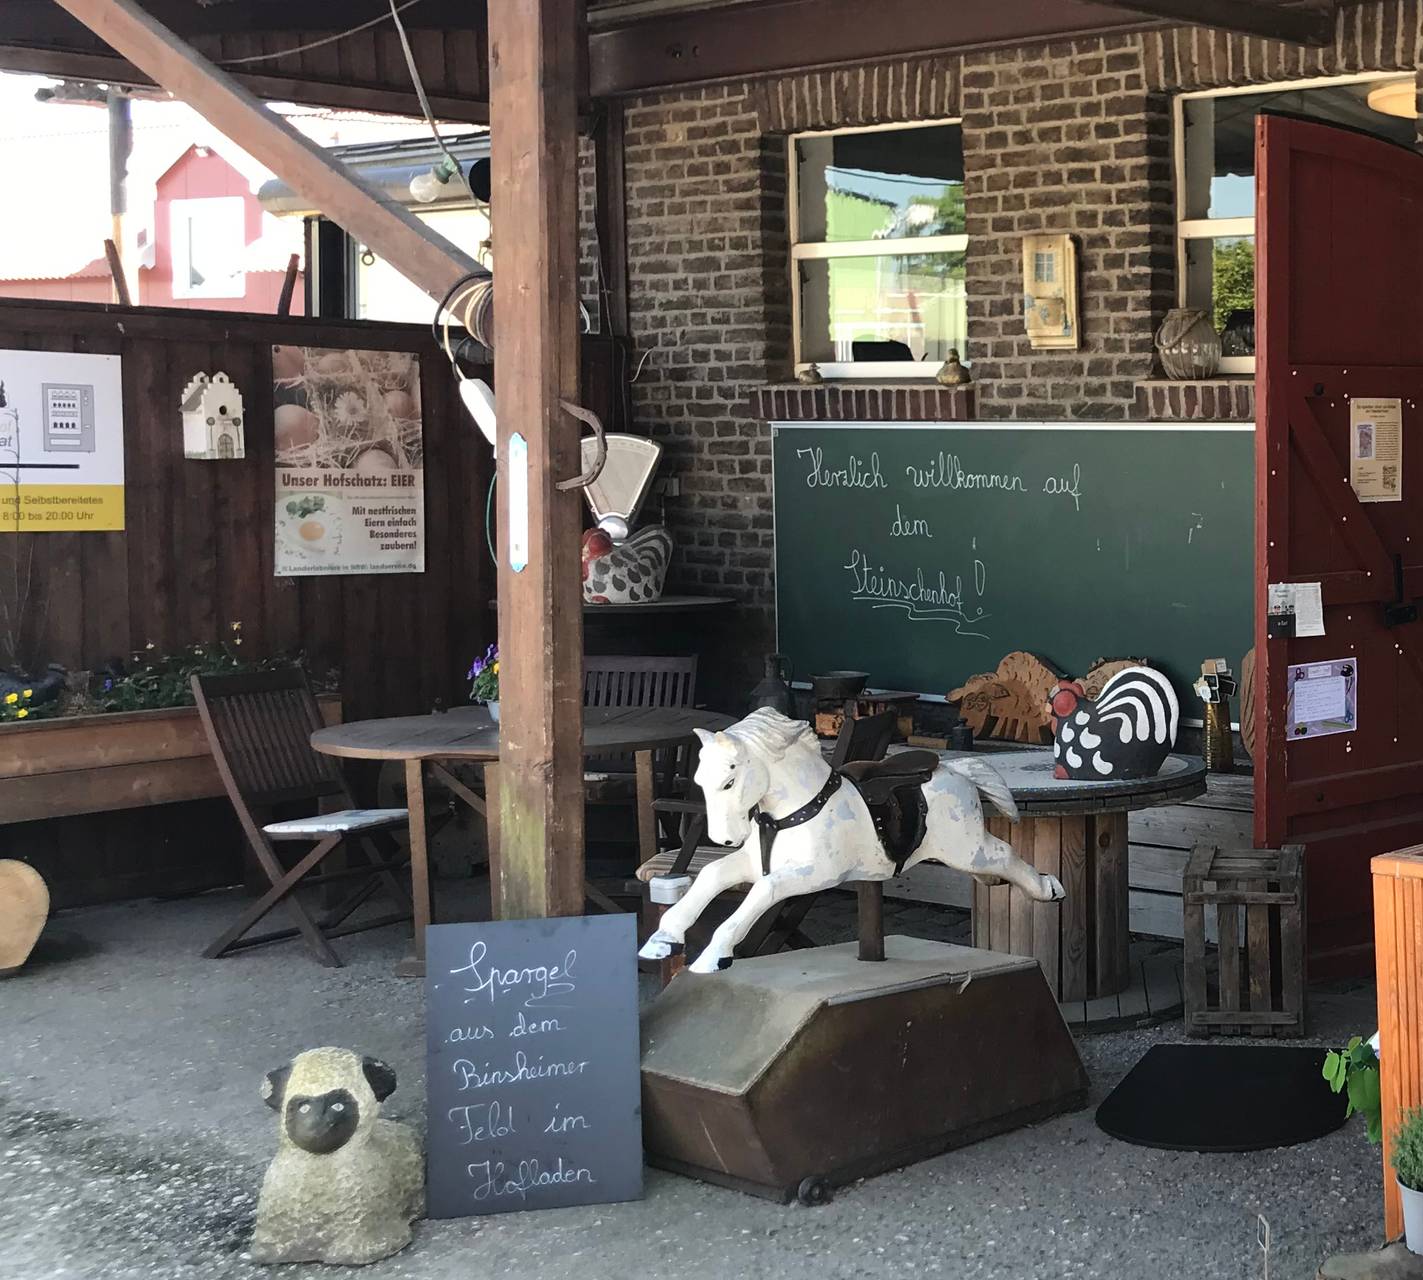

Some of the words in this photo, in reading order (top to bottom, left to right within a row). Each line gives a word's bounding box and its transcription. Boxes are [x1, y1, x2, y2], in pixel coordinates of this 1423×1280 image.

[282, 473, 320, 488] Unser
[323, 473, 388, 488] Hofschatz:
[391, 474, 416, 488] EIER
[797, 448, 888, 489] Herzlich
[906, 451, 1028, 492] willkommen
[1043, 463, 1082, 512] auf
[77, 511, 94, 521] Uhr
[352, 506, 366, 516] Mit
[368, 505, 417, 516] nestfrischen
[364, 518, 386, 528] Eiern
[387, 517, 417, 528] einfach
[890, 504, 933, 538] dem
[369, 530, 417, 540] Besonderes
[380, 541, 417, 551] zaubern!
[450, 941, 577, 1003] Spargel
[446, 1024, 494, 1043] aus
[509, 1012, 567, 1038] dem
[453, 1051, 590, 1092] Binsheimer
[448, 1100, 517, 1145] Feld
[544, 1102, 592, 1134] im
[467, 1157, 598, 1201] Hofladen
